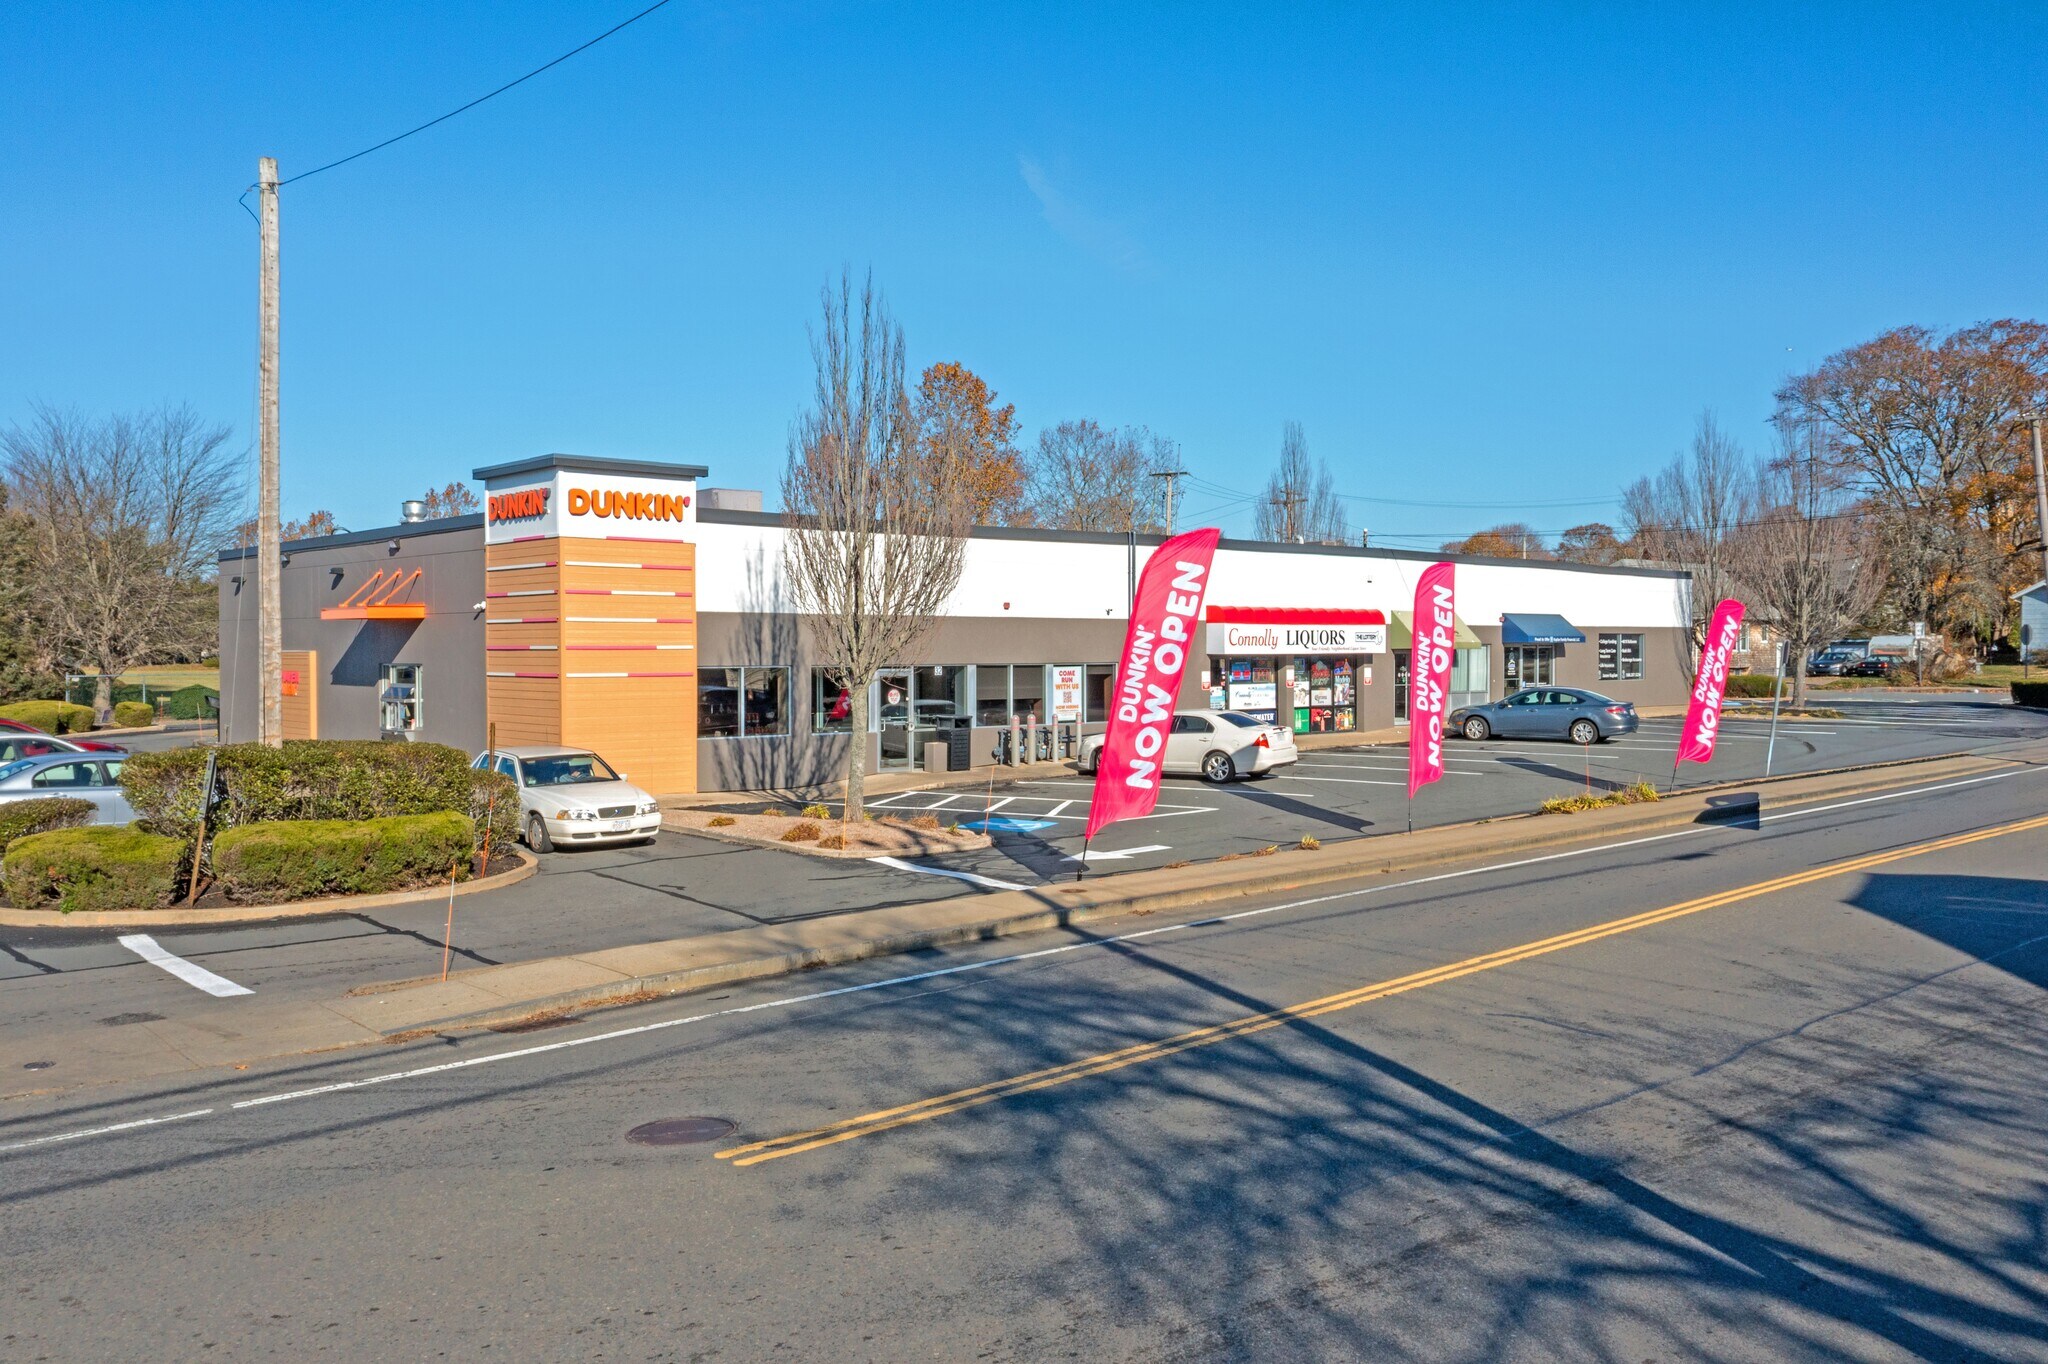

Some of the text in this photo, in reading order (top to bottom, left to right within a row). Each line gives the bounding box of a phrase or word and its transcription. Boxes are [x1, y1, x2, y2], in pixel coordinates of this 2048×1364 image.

[488, 487, 549, 521] DUNKIN'
[567, 488, 691, 522] DUNKIN'
[1118, 624, 1155, 723] DUNKIN'
[1126, 560, 1206, 789] NOW OPEN
[1229, 628, 1345, 650] Connolly LIQUORS
[1416, 631, 1431, 711] DUNKIN'
[1428, 584, 1454, 767] NOW OPEN
[1695, 643, 1716, 702] DUNKIN'
[1696, 615, 1739, 748] NOW OPEN
